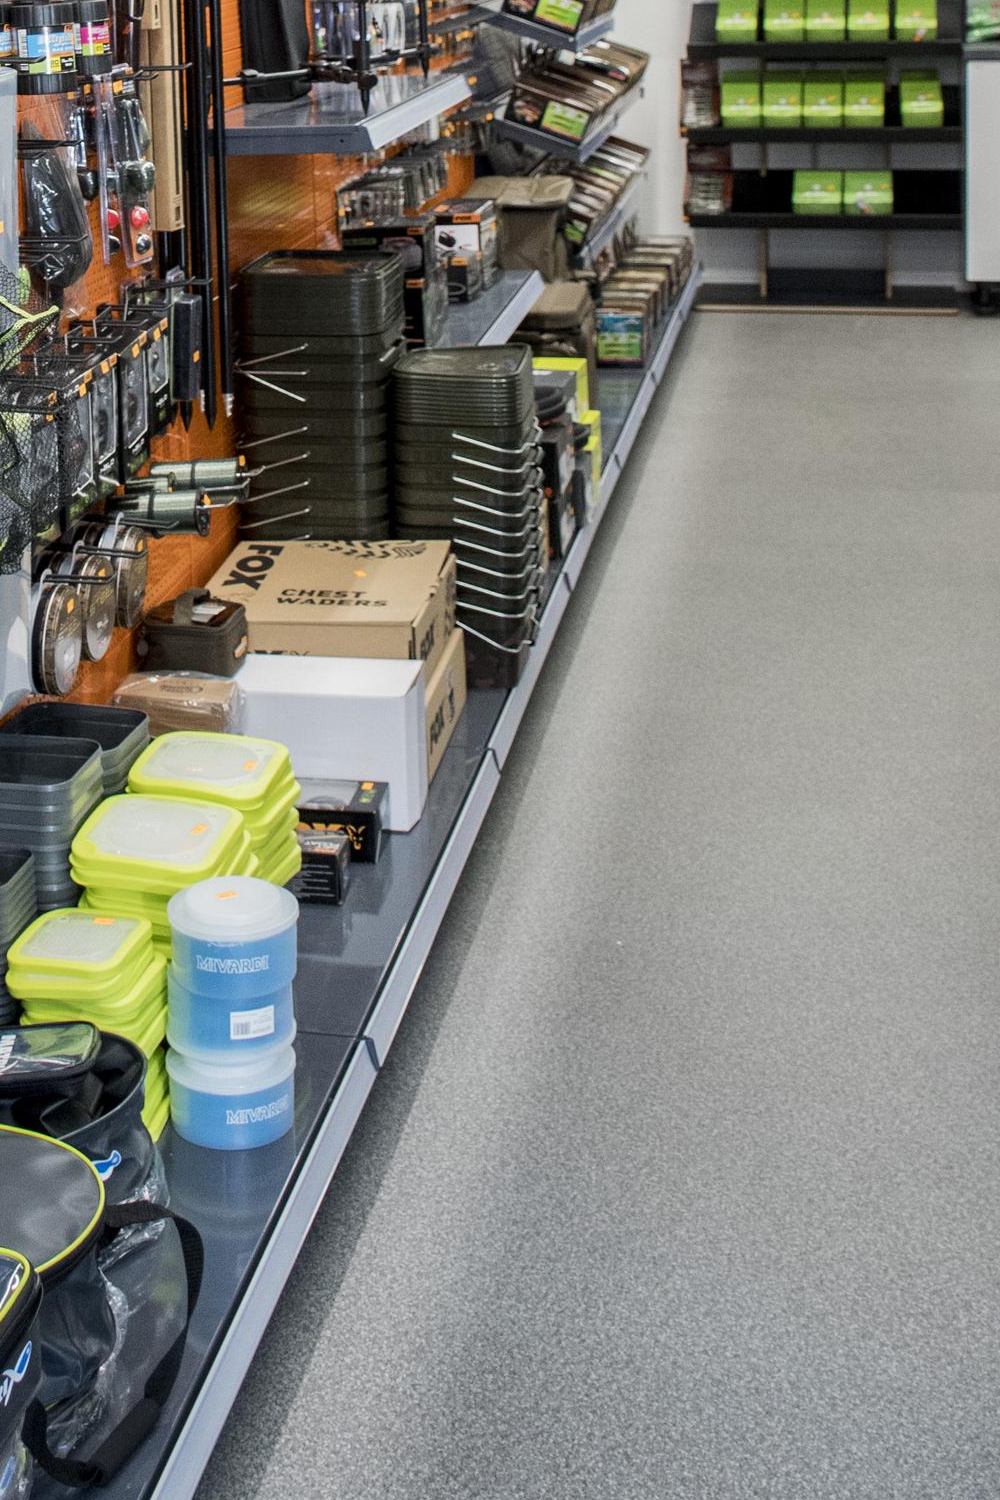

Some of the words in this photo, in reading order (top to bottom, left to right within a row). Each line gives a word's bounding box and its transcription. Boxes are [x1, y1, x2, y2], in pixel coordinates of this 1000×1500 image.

[222, 543, 286, 591] FOX
[280, 588, 368, 598] CHEST
[276, 596, 389, 608] WADERS
[195, 954, 270, 974] MIVARDI
